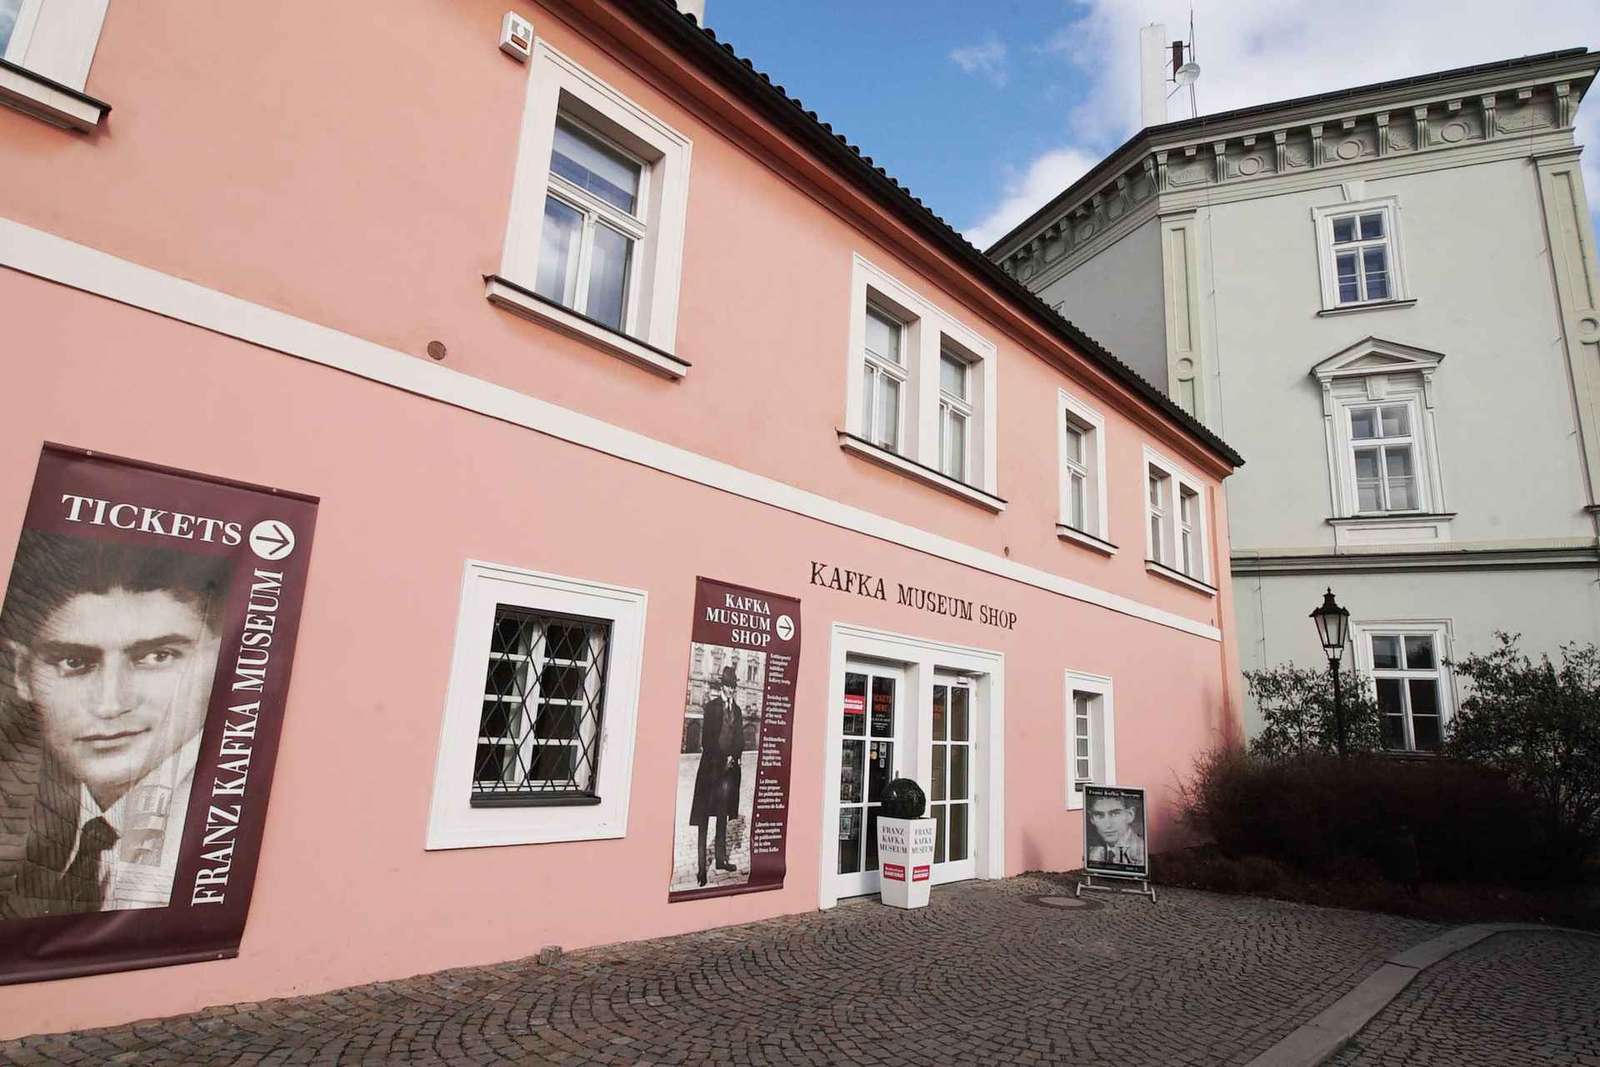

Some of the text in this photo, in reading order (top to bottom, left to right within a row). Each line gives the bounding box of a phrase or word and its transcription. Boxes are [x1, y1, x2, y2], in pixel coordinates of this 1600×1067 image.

[61, 494, 242, 546] TICKETS
[725, 593, 771, 615] KAFKA
[809, 561, 1017, 630] KAFKA MUSEUM SHOP
[706, 606, 771, 631] MUSEUM
[731, 628, 771, 647] SHOP
[190, 568, 284, 908] FRANZ KAFKA MUSEUM
[881, 835, 905, 845] KAFKA
[882, 825, 905, 836] FRANZ
[879, 843, 908, 854] MUSEUM
